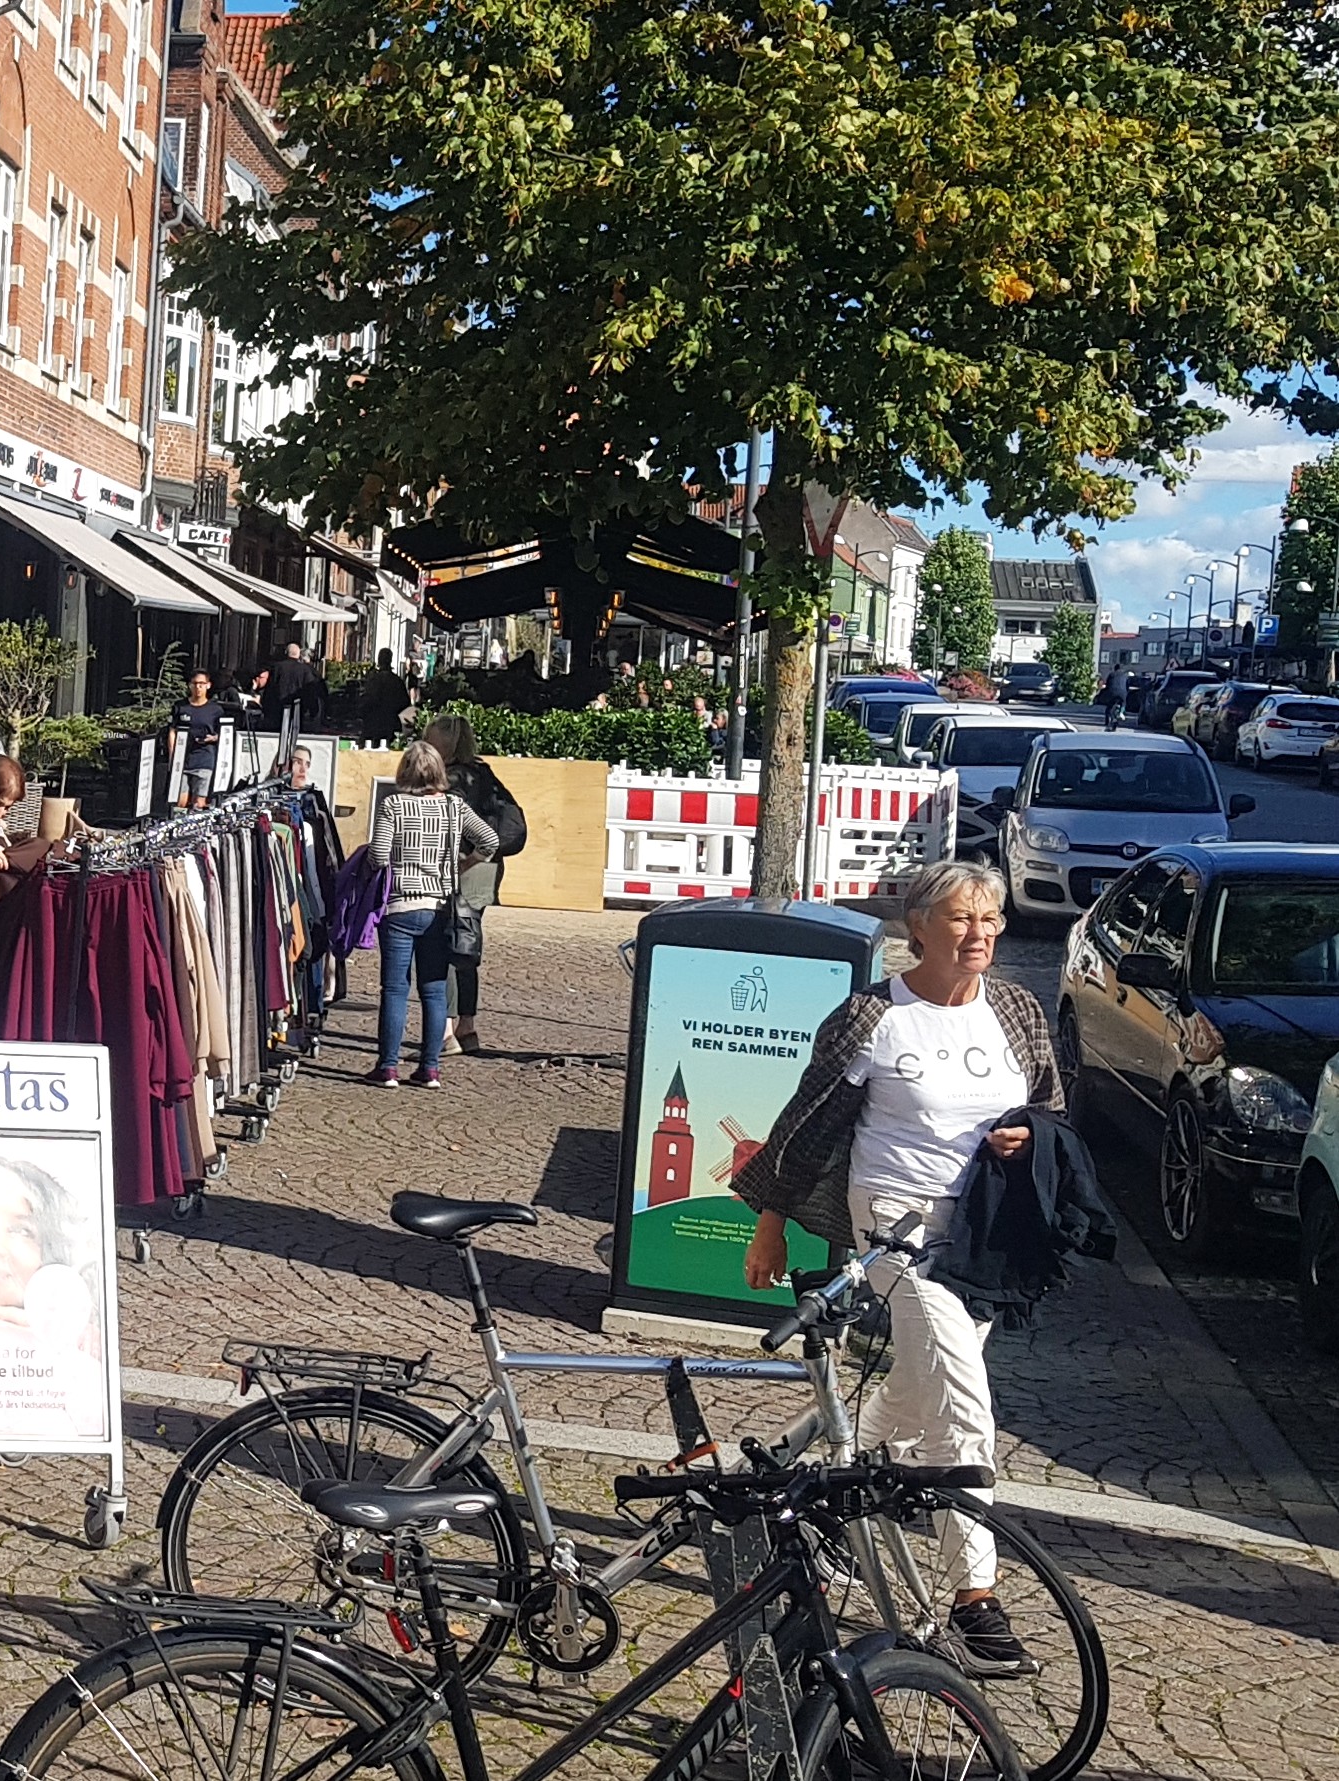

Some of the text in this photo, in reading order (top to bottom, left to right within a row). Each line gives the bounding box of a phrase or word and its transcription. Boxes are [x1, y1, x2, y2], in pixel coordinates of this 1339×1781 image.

[1262, 619, 1273, 633] P
[682, 1019, 812, 1043] VI HOLDER BYEN
[691, 1037, 798, 1059] REN SAMMEN
[15, 1346, 36, 1359] for
[12, 1364, 54, 1378] tilbud
